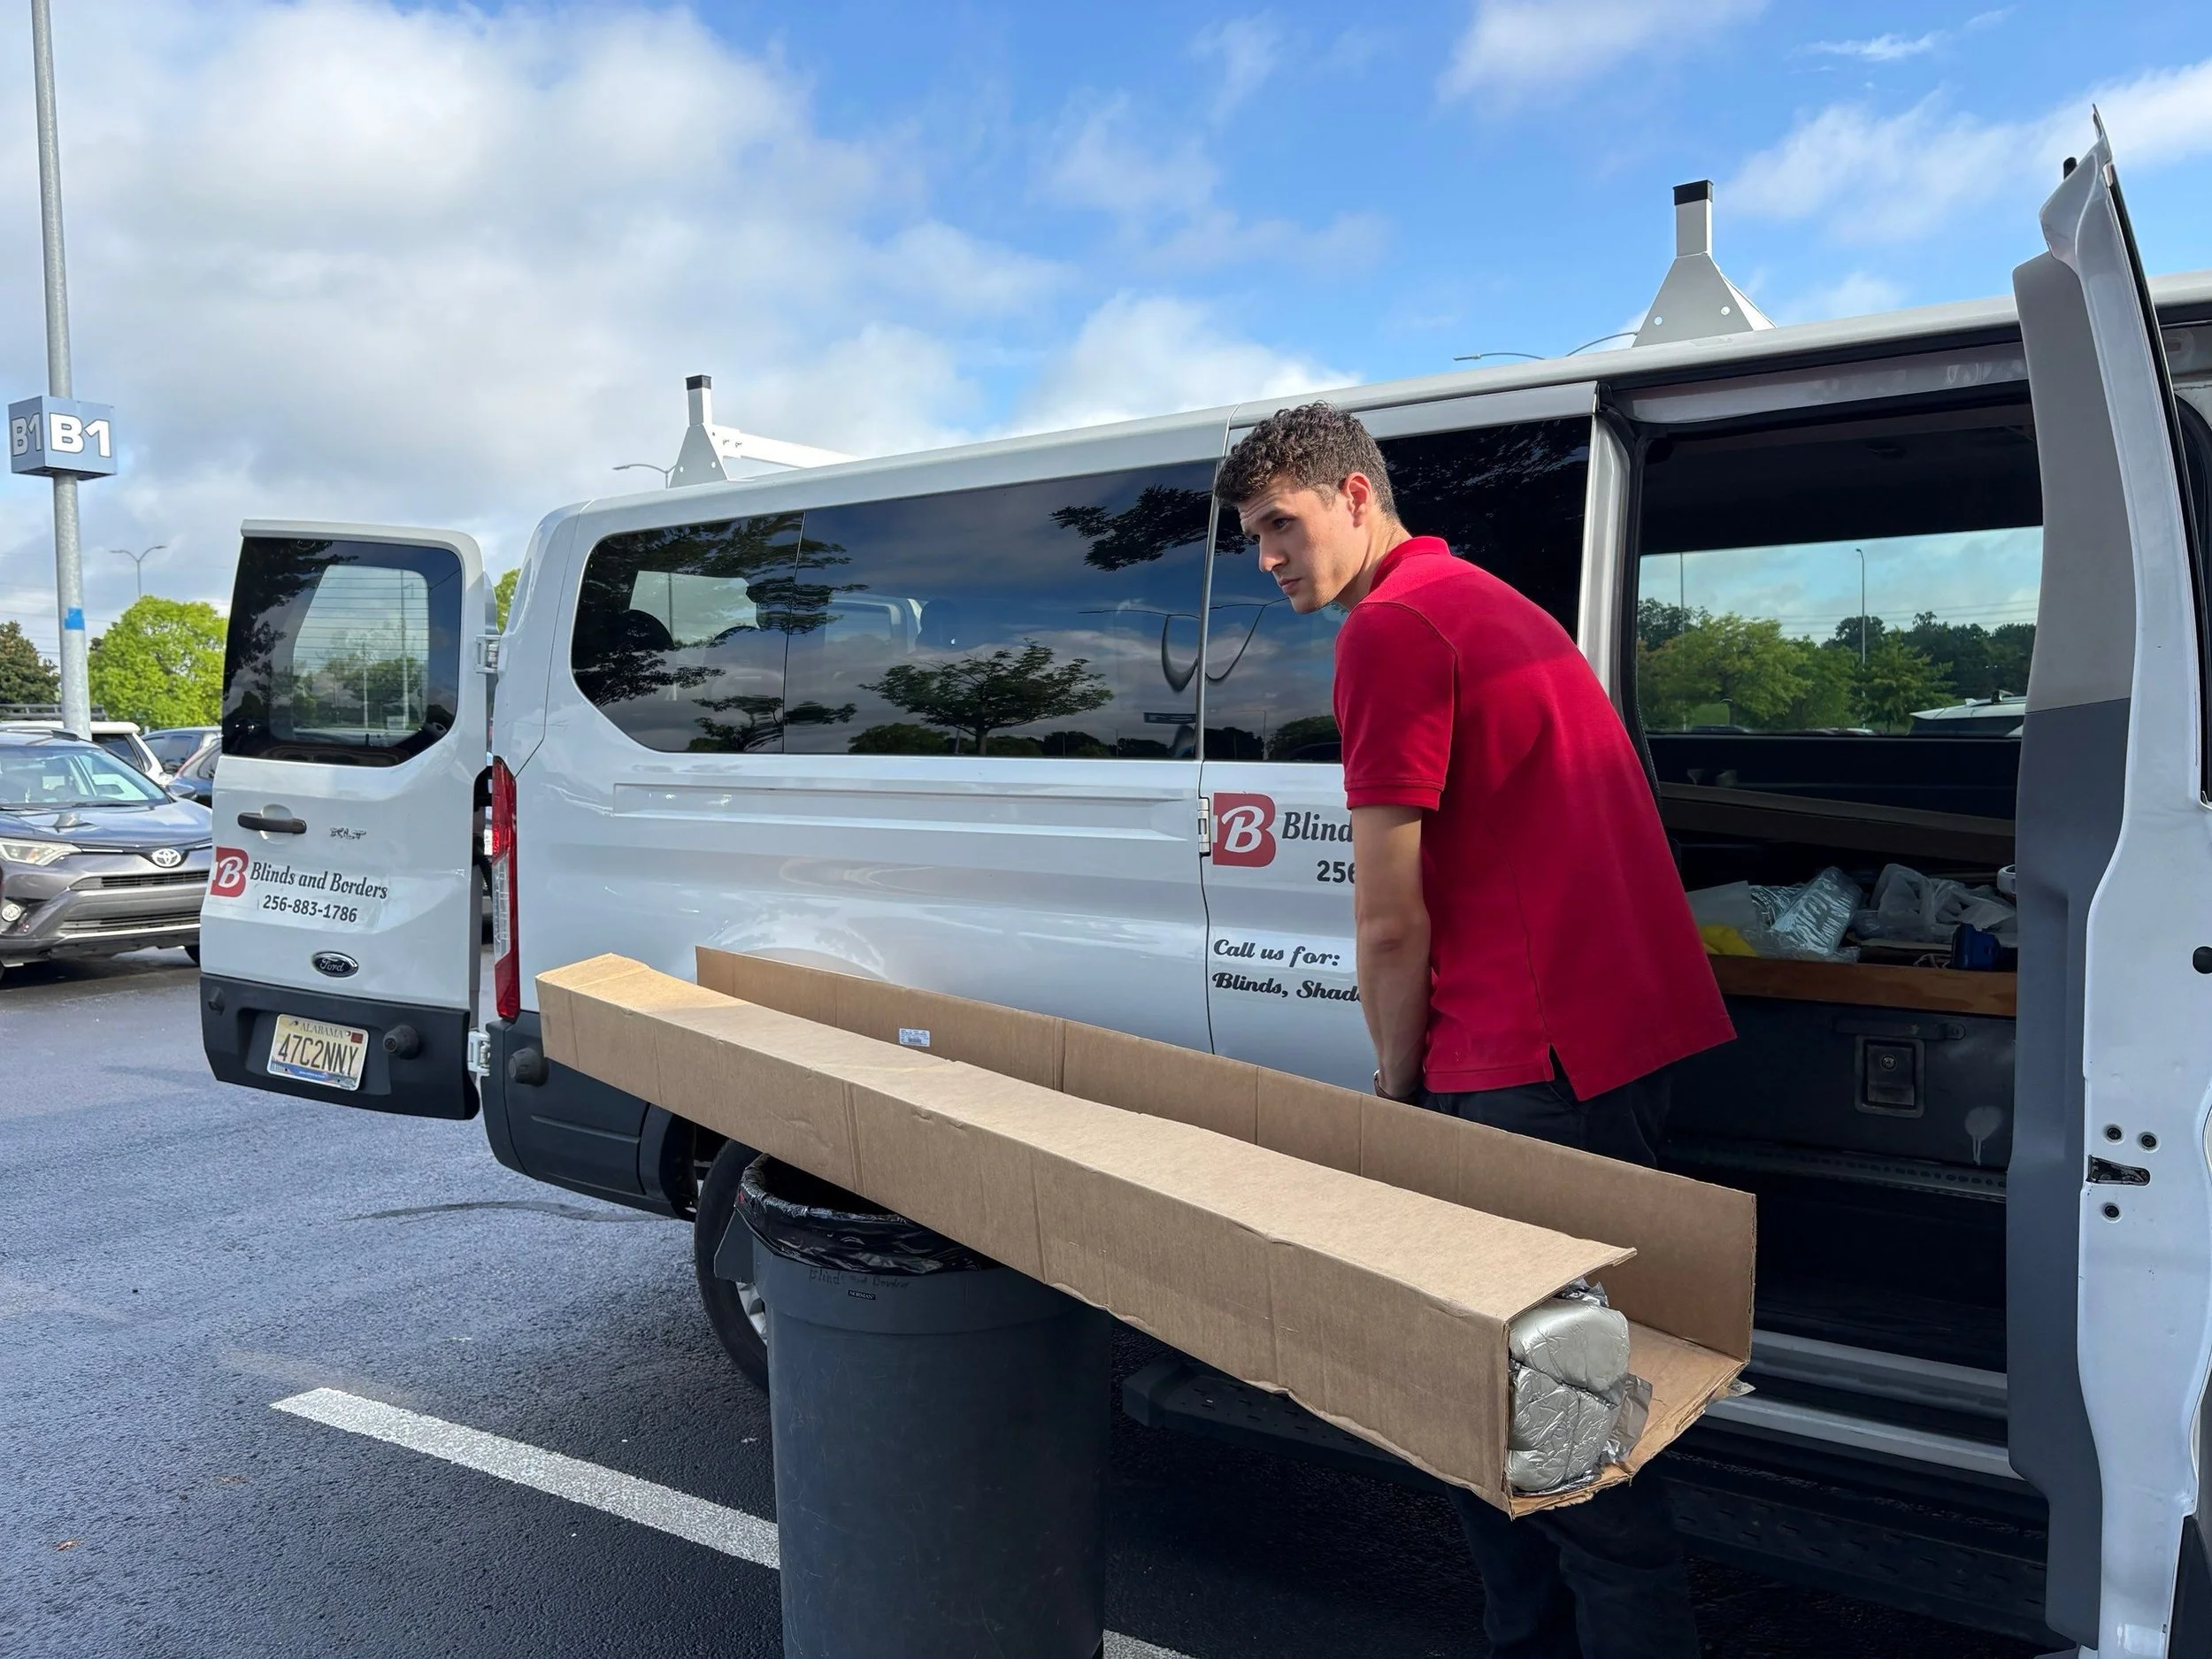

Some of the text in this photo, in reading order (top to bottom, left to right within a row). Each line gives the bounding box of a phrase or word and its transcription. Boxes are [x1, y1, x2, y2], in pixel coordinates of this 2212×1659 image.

[11, 412, 42, 457] B1
[50, 412, 111, 457] B1
[250, 862, 388, 899] Blinds and Borders
[263, 895, 357, 922] 256-883-1786
[319, 956, 345, 972] Ford
[1213, 939, 1340, 968] Call us for:
[1212, 972, 1289, 998] Blinds,
[299, 1022, 344, 1039] ALABAMA
[278, 1033, 358, 1077] 47C2NNY
